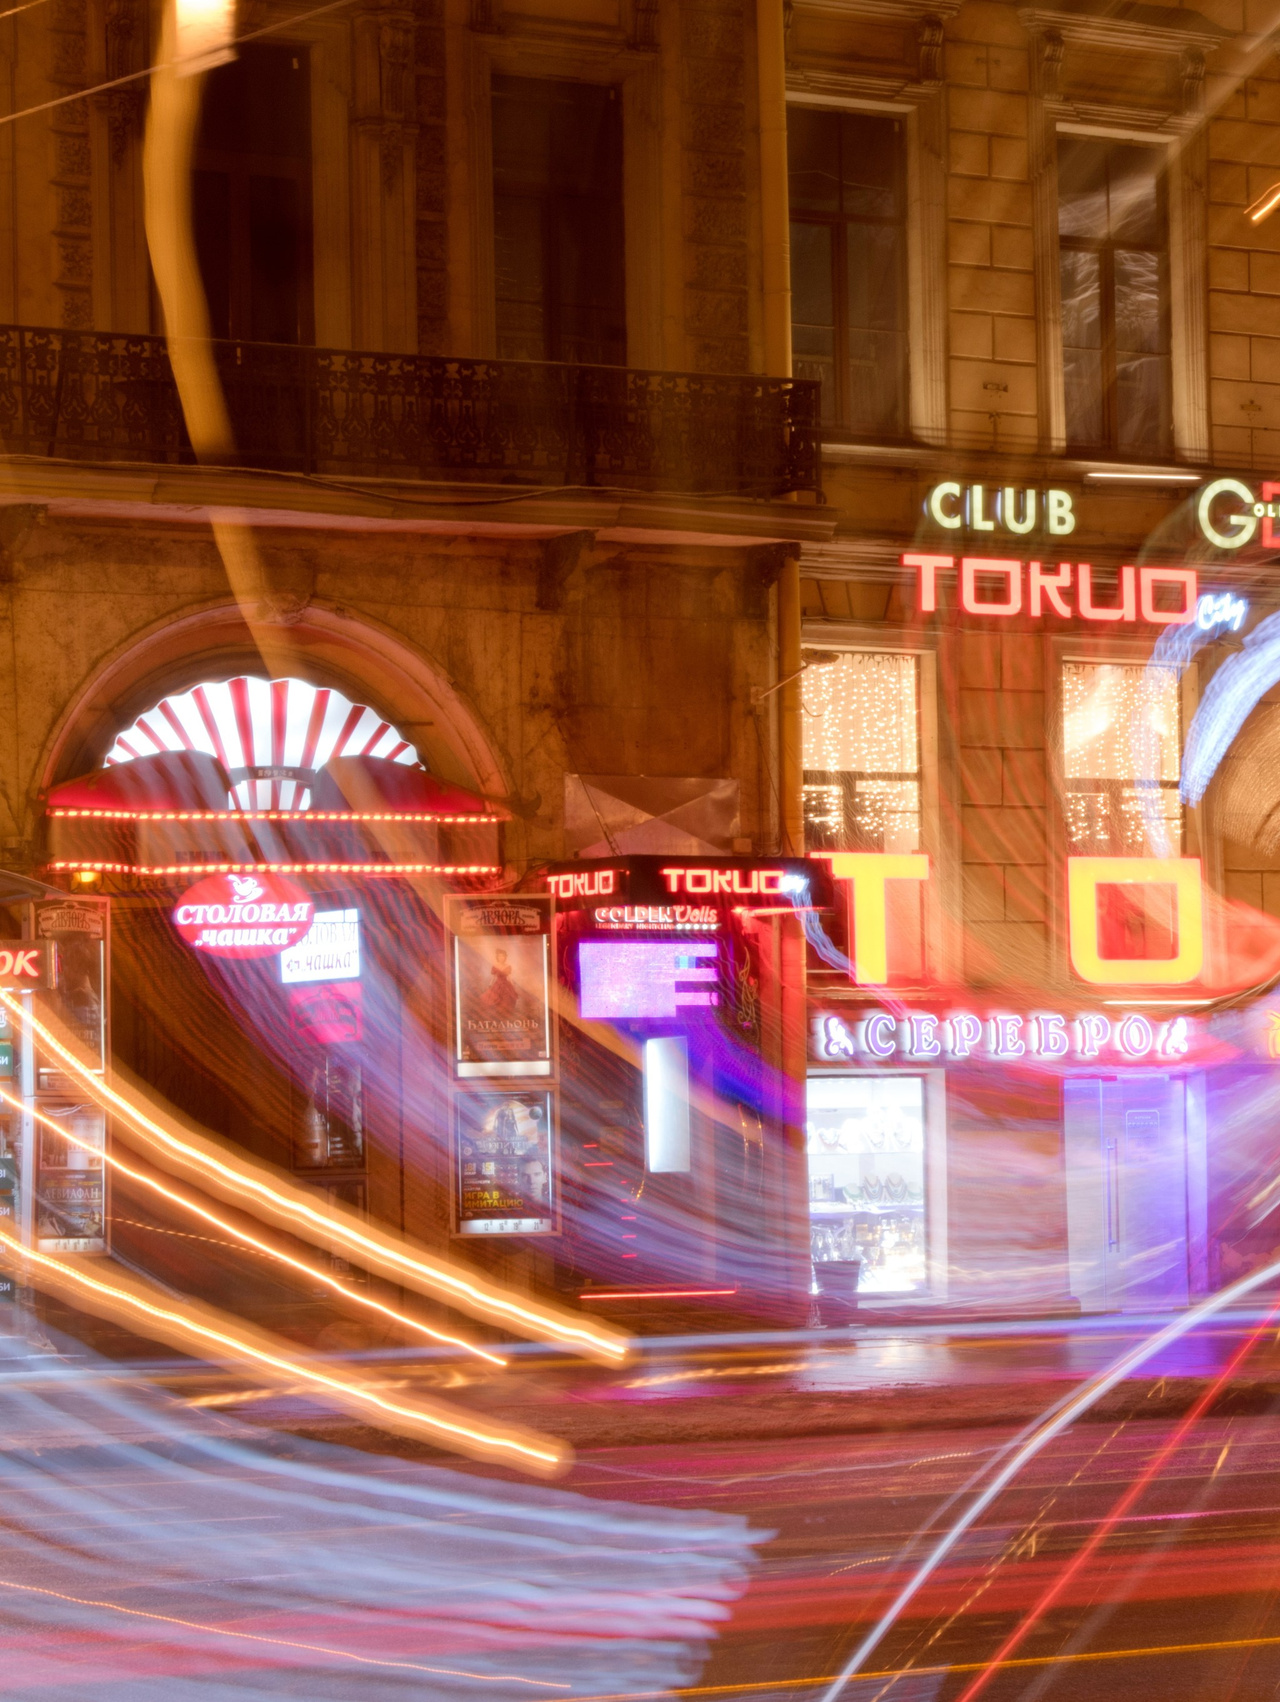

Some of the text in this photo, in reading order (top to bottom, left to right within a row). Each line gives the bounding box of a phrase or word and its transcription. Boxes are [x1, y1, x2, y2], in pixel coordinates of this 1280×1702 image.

[929, 482, 1076, 536] CLUB
[177, 903, 311, 925] СТОЛОВАЯ
[594, 906, 673, 923] GOLDEN
[866, 1013, 1153, 1057] СЕРЕБРО
[464, 1190, 500, 1200] ИГРА В
[464, 1199, 524, 1209] ИМИТАЦИЮ
